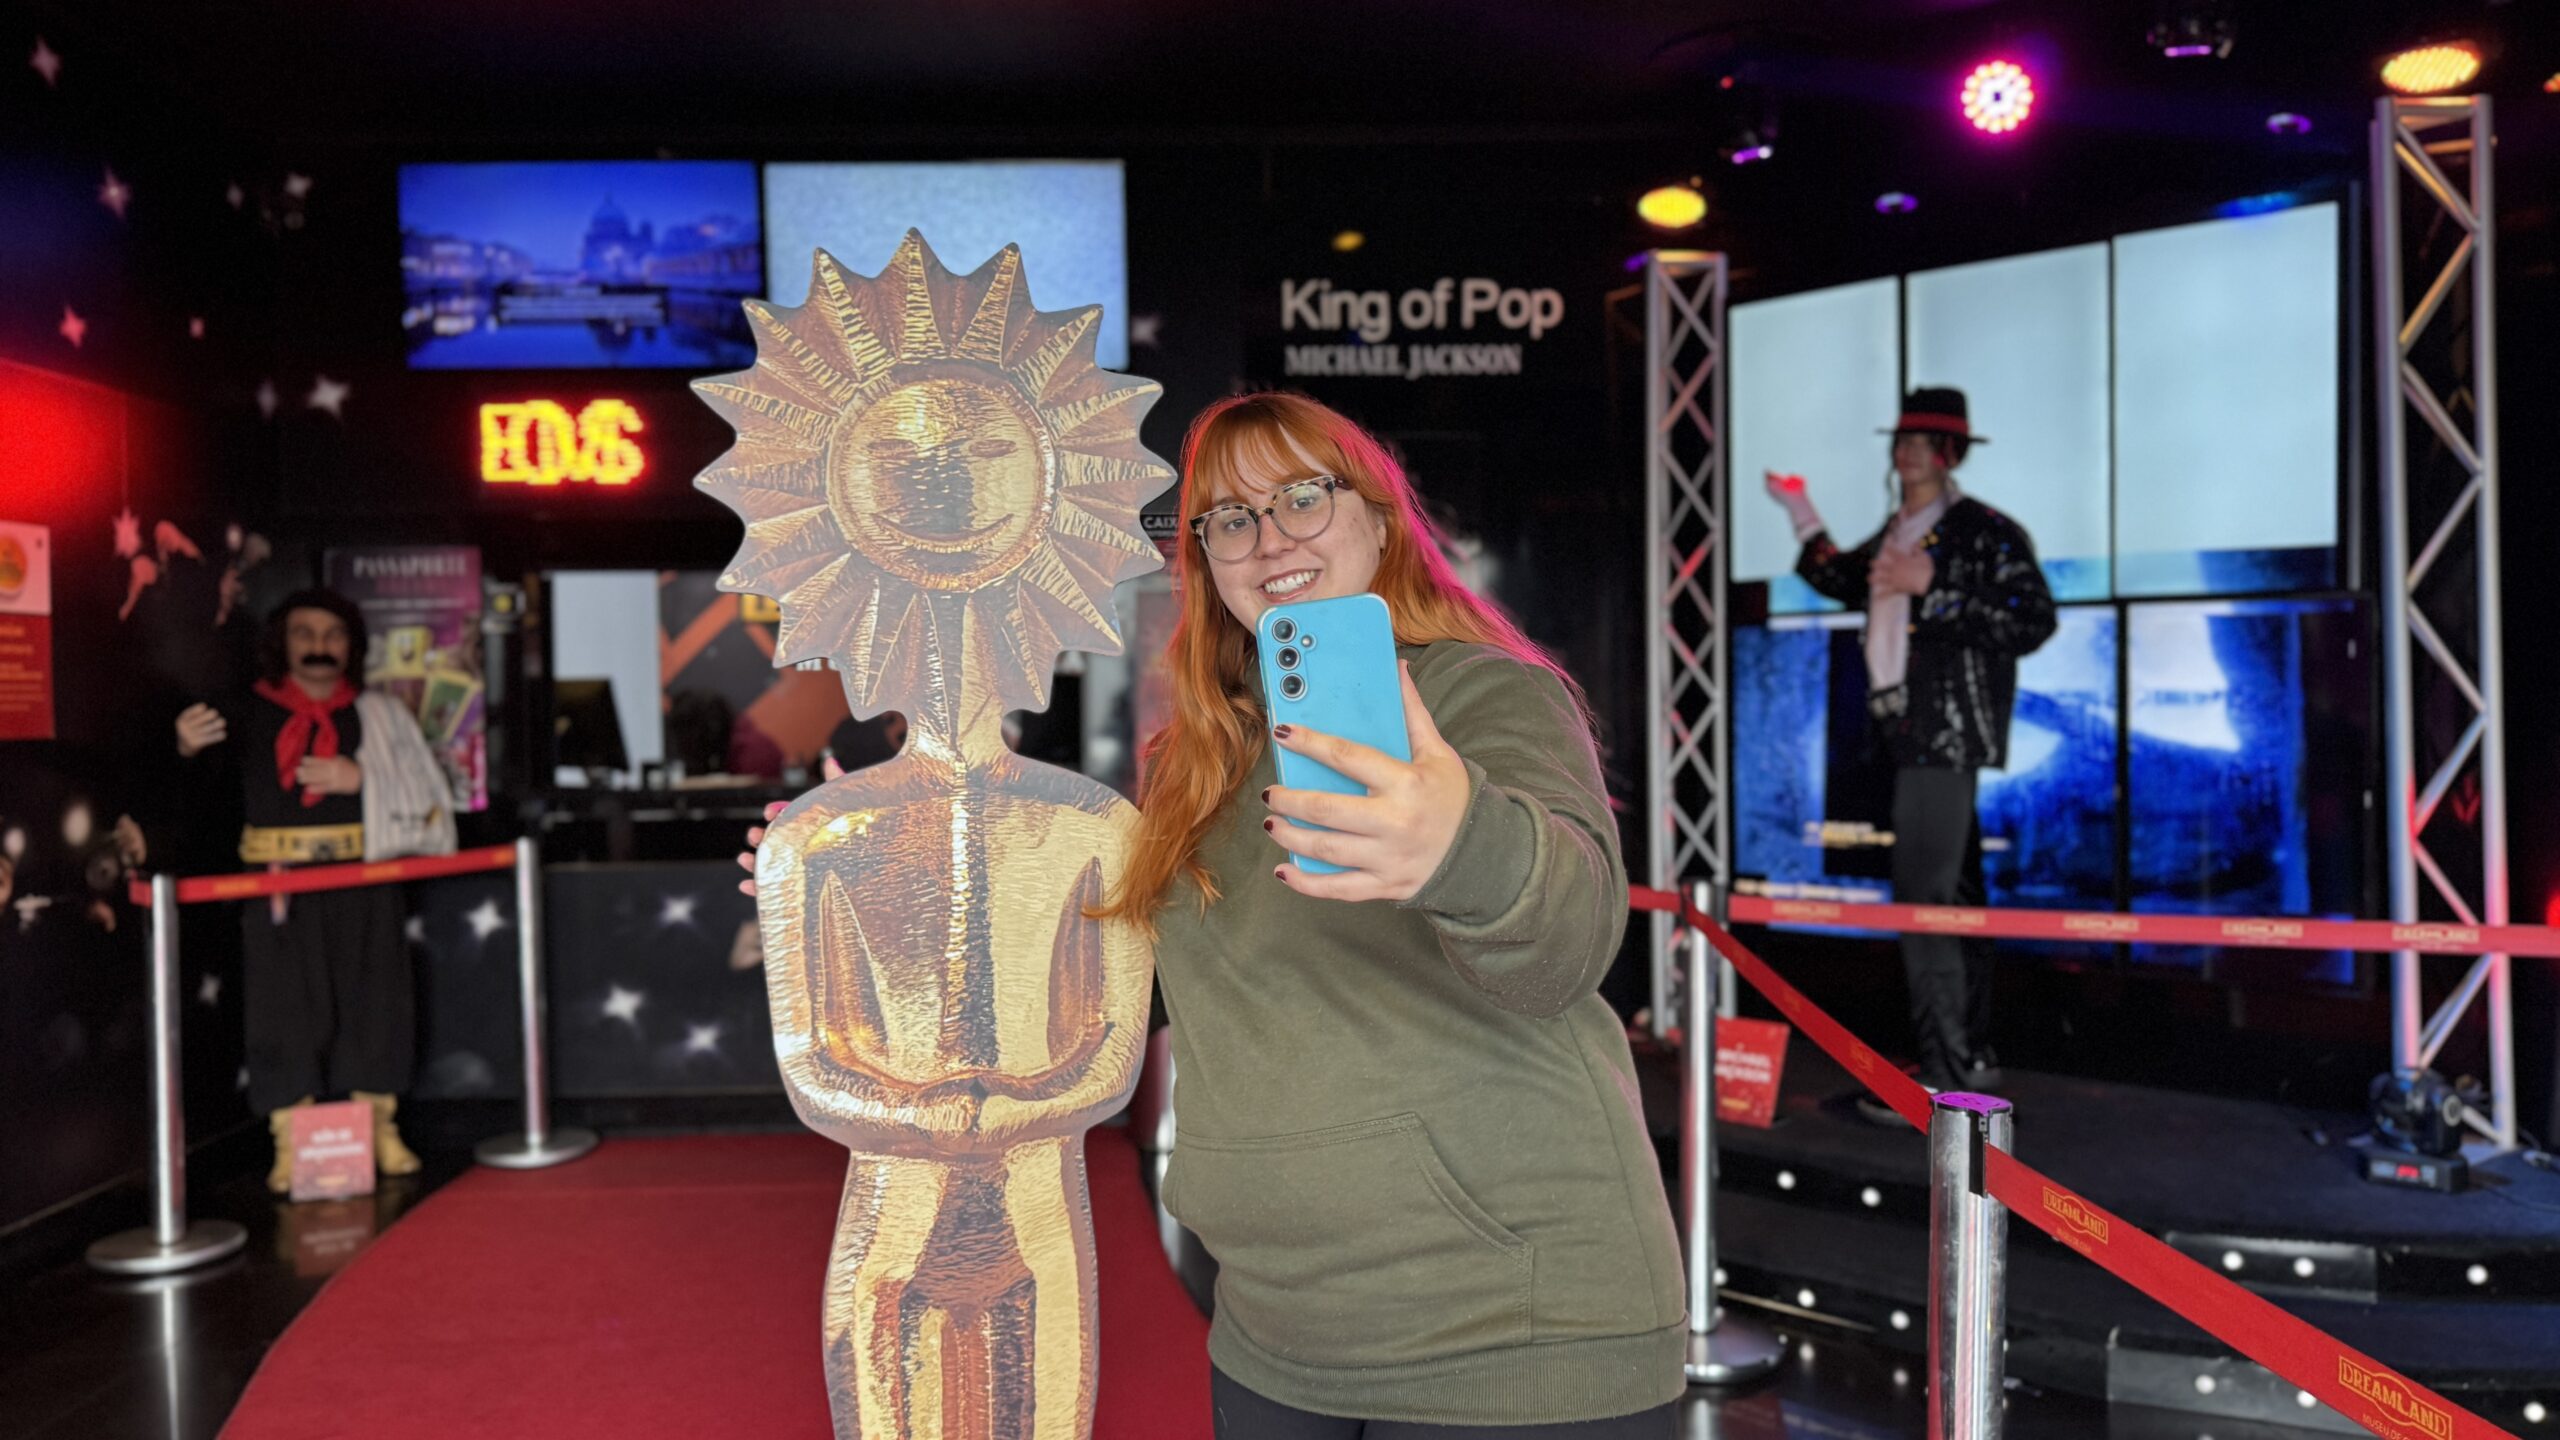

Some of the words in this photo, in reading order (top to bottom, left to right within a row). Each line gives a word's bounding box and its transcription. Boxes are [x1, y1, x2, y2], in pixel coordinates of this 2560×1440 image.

[1281, 277, 1391, 343] King
[1399, 276, 1456, 331] of
[1461, 277, 1565, 340] Pop
[1284, 344, 1402, 376] MICHAEL
[1405, 343, 1523, 381] JACKSON
[1143, 516, 1178, 529] CAIX
[2045, 1191, 2105, 1238] DREAMLAND
[2342, 1361, 2447, 1436] DREAMLAND
[2362, 1413, 2390, 1436] MUSEU
